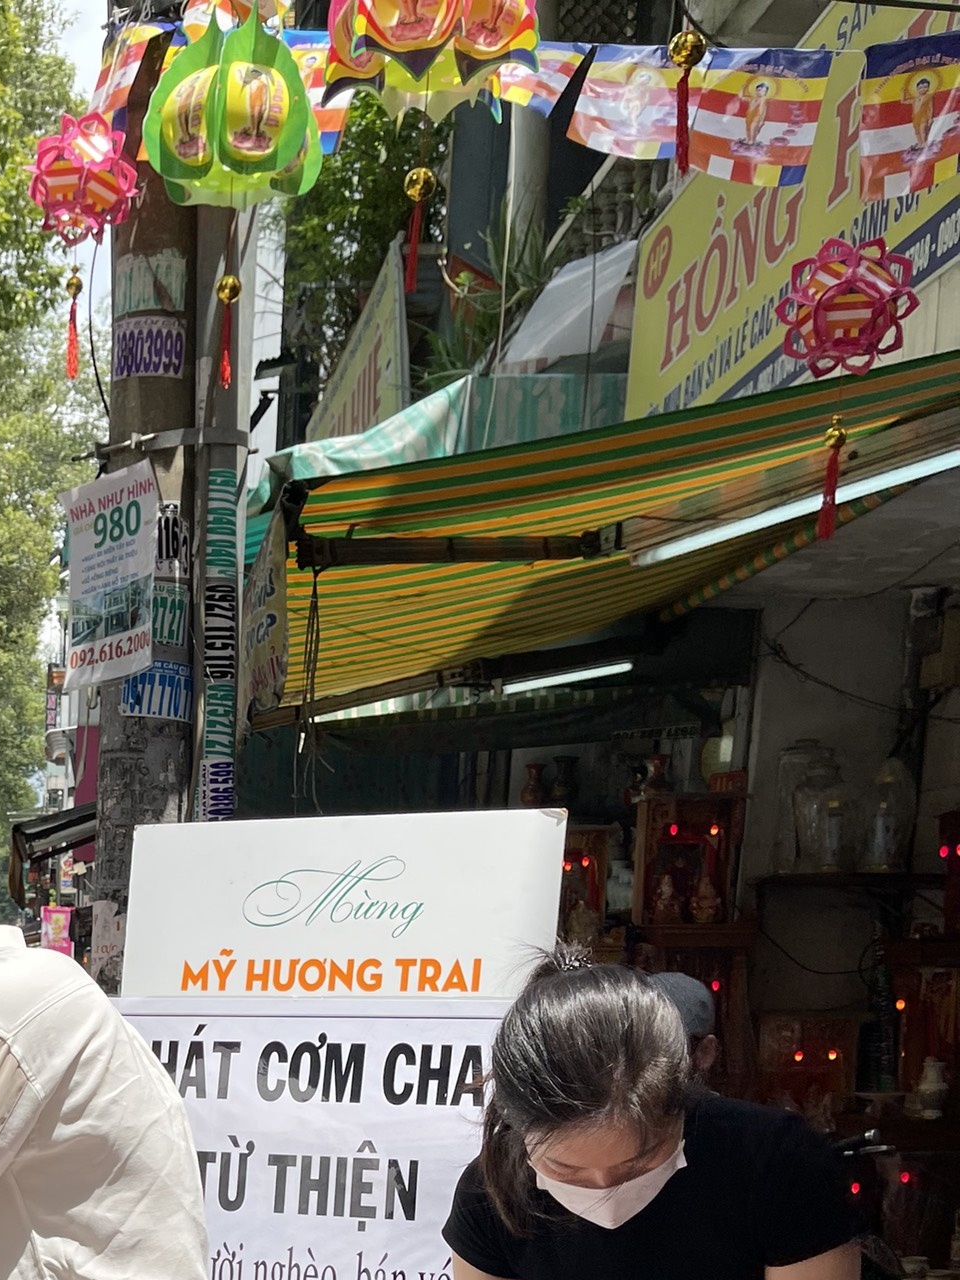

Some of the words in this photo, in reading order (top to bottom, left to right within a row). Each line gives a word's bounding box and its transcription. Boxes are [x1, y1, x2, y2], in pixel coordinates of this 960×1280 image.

[648, 233, 670, 280] HP
[93, 499, 142, 550] 980
[242, 855, 425, 939] Mừng
[180, 948, 236, 993] MỸ
[245, 955, 385, 993] HƯƠNG
[395, 957, 483, 993] TRAI
[256, 1031, 365, 1105] CƠM
[197, 1135, 256, 1212] TỪ
[267, 1140, 419, 1232] THIỆN
